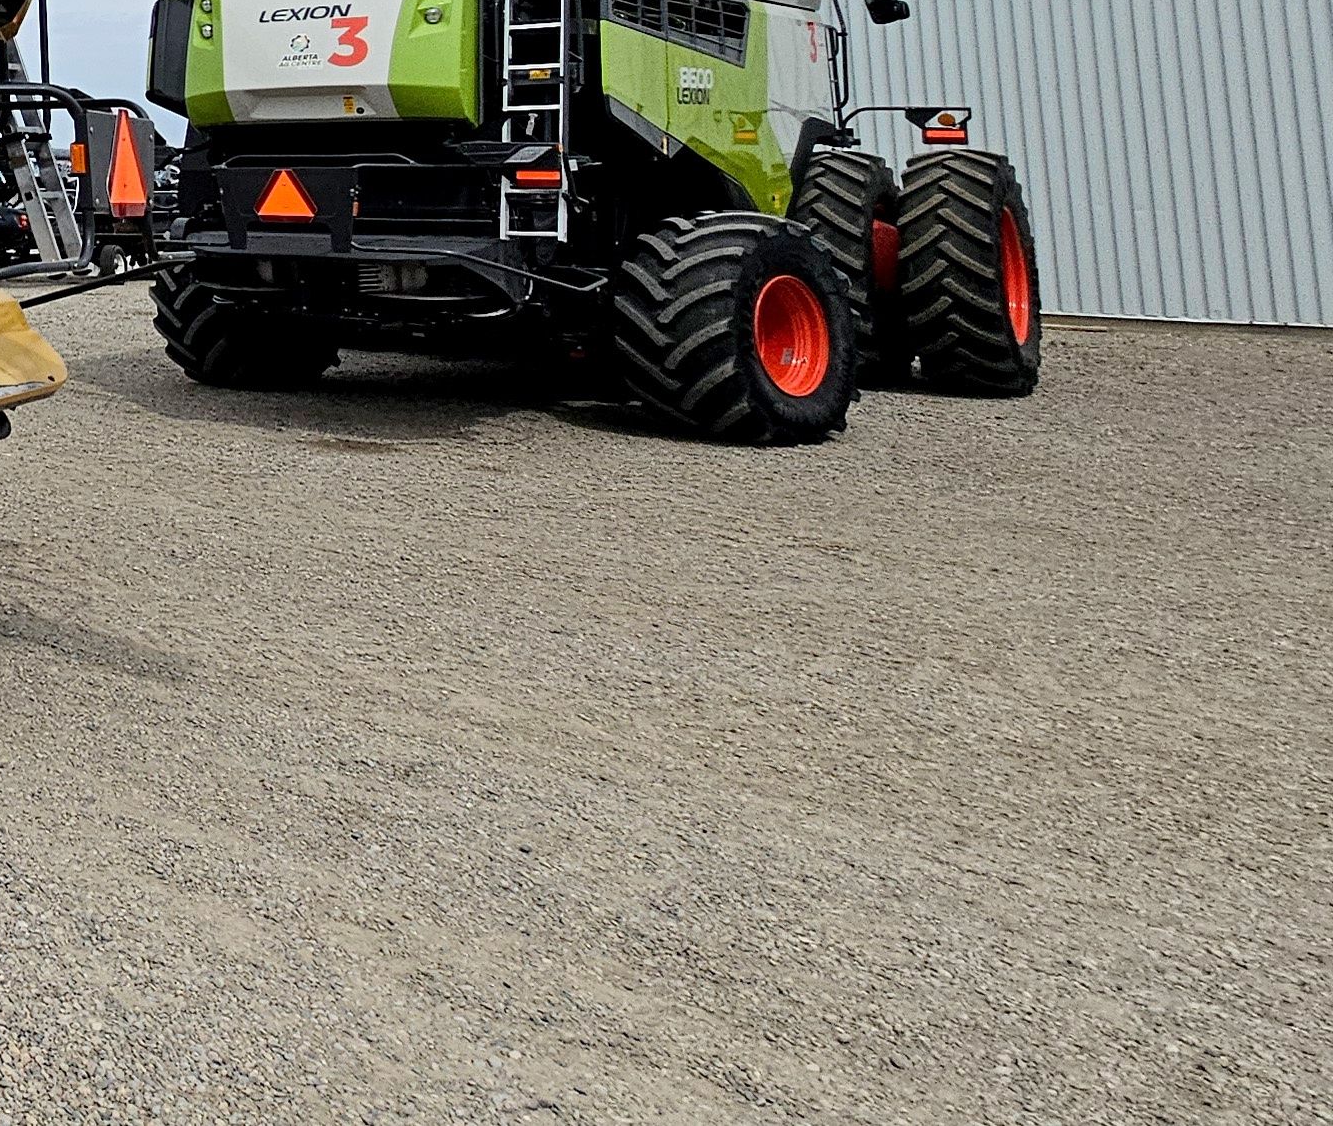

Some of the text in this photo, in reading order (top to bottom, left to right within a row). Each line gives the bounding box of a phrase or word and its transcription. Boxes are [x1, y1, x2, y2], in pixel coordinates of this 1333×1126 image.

[259, 4, 352, 23] LEXION
[327, 16, 369, 67] 3
[807, 21, 818, 63] 3
[676, 87, 710, 105] LEXION
